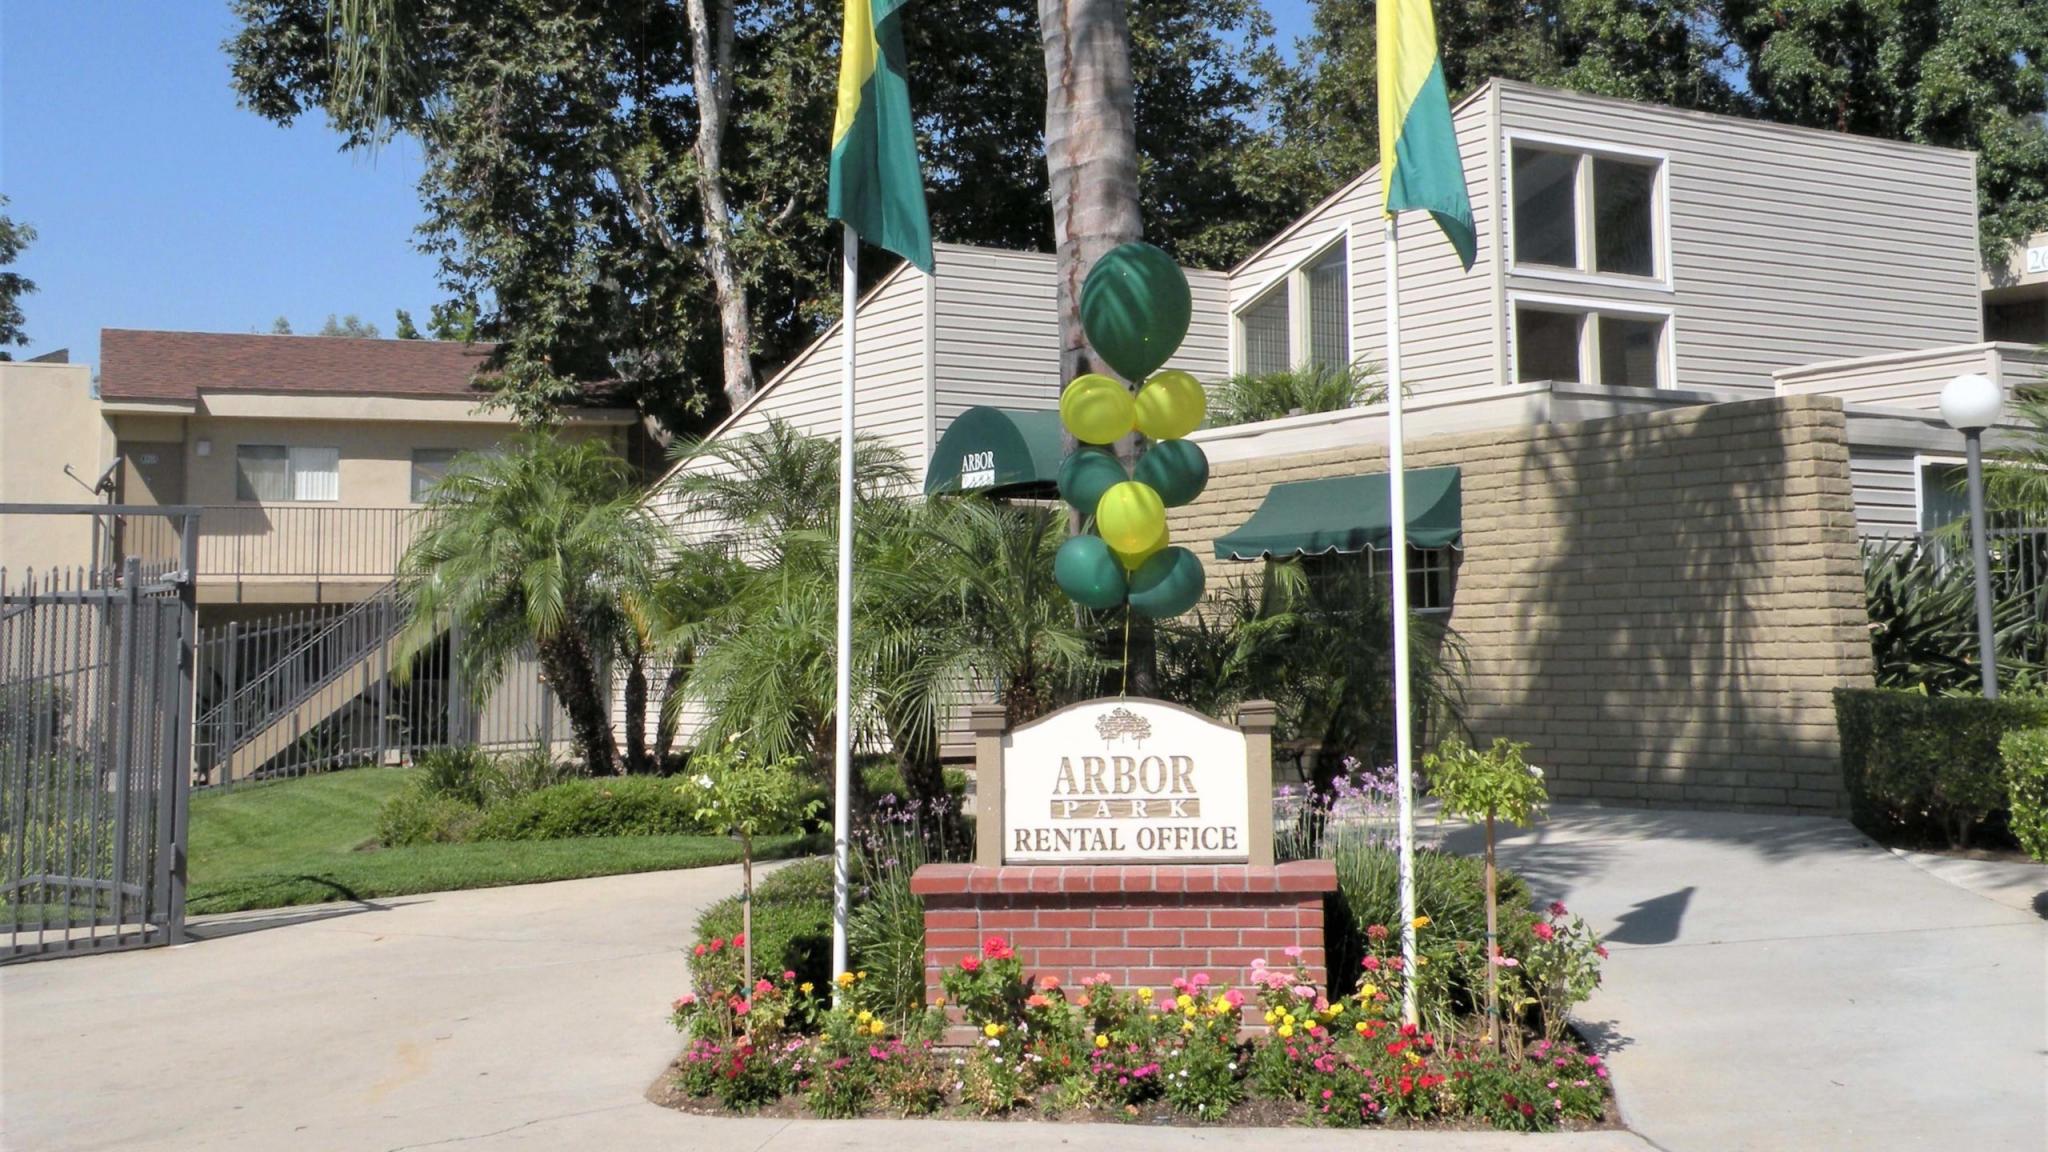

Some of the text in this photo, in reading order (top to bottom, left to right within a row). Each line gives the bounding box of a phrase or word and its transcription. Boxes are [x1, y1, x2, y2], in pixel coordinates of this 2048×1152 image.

[961, 451, 995, 473] ARBOR
[1053, 755, 1197, 795] ARBOR
[1062, 799, 1188, 819] PARK
[1014, 826, 1238, 851] RENTAL OFFICE
